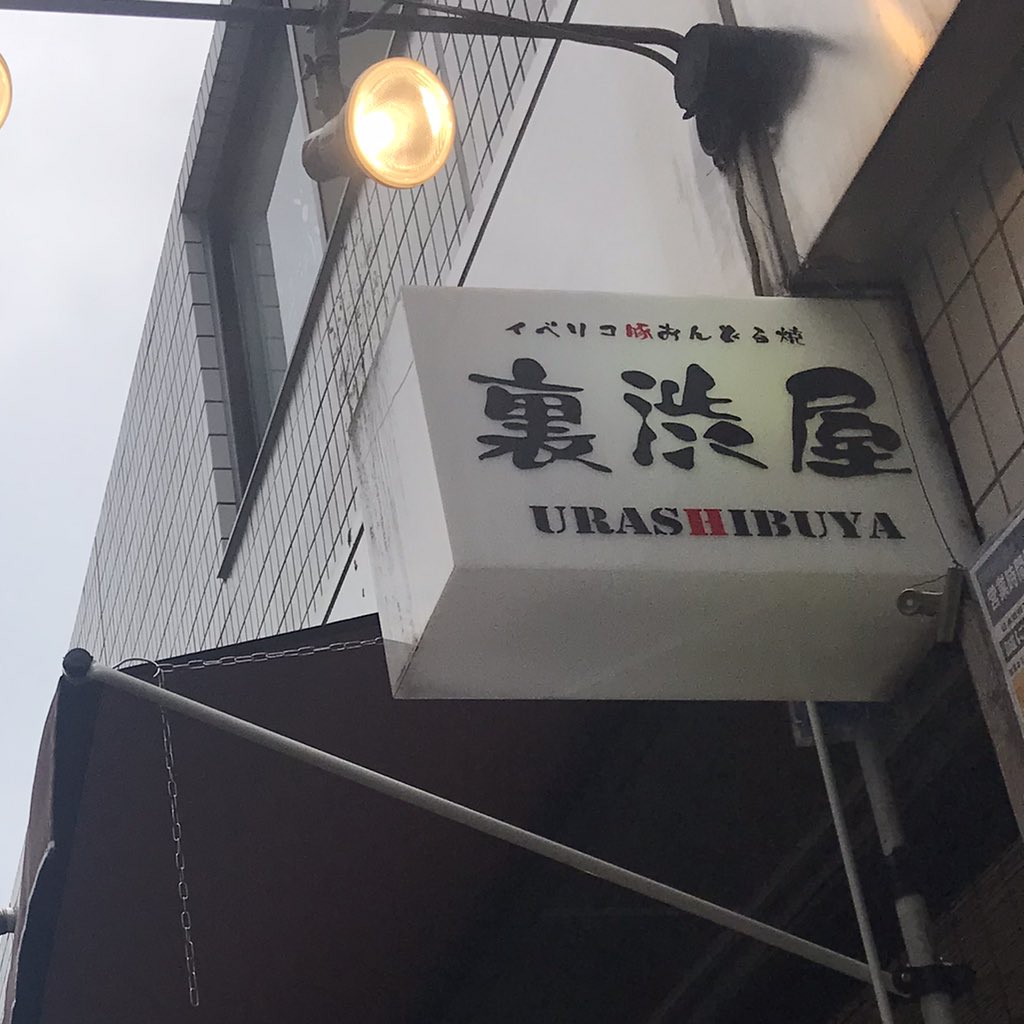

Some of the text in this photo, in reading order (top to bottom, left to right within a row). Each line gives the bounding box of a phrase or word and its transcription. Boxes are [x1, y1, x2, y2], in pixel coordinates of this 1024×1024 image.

[468, 357, 913, 478] 裏渋屋
[529, 505, 906, 540] URASHIBUYA
